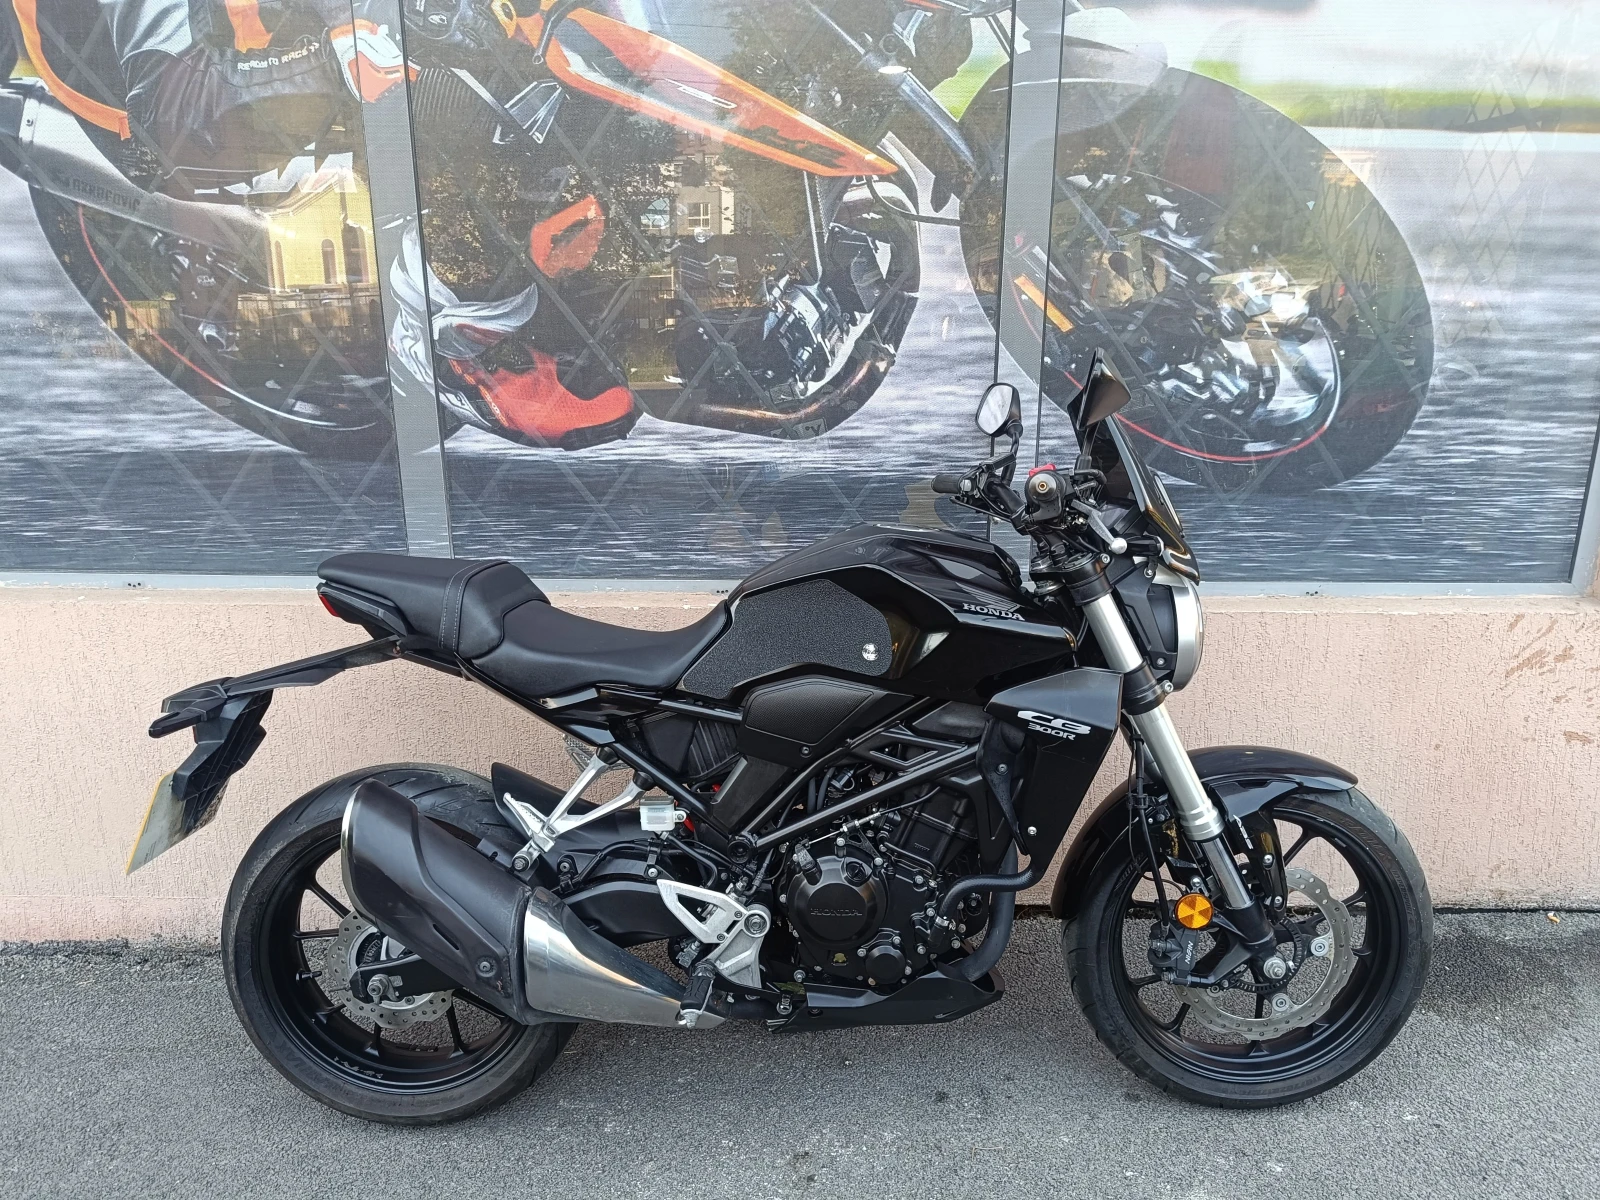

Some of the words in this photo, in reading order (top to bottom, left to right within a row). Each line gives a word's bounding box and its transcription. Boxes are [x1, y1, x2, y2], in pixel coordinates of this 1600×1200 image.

[962, 602, 1025, 621] HONDA
[1017, 710, 1091, 734] CB
[1027, 722, 1076, 740] 300R
[810, 907, 863, 917] HONDA
